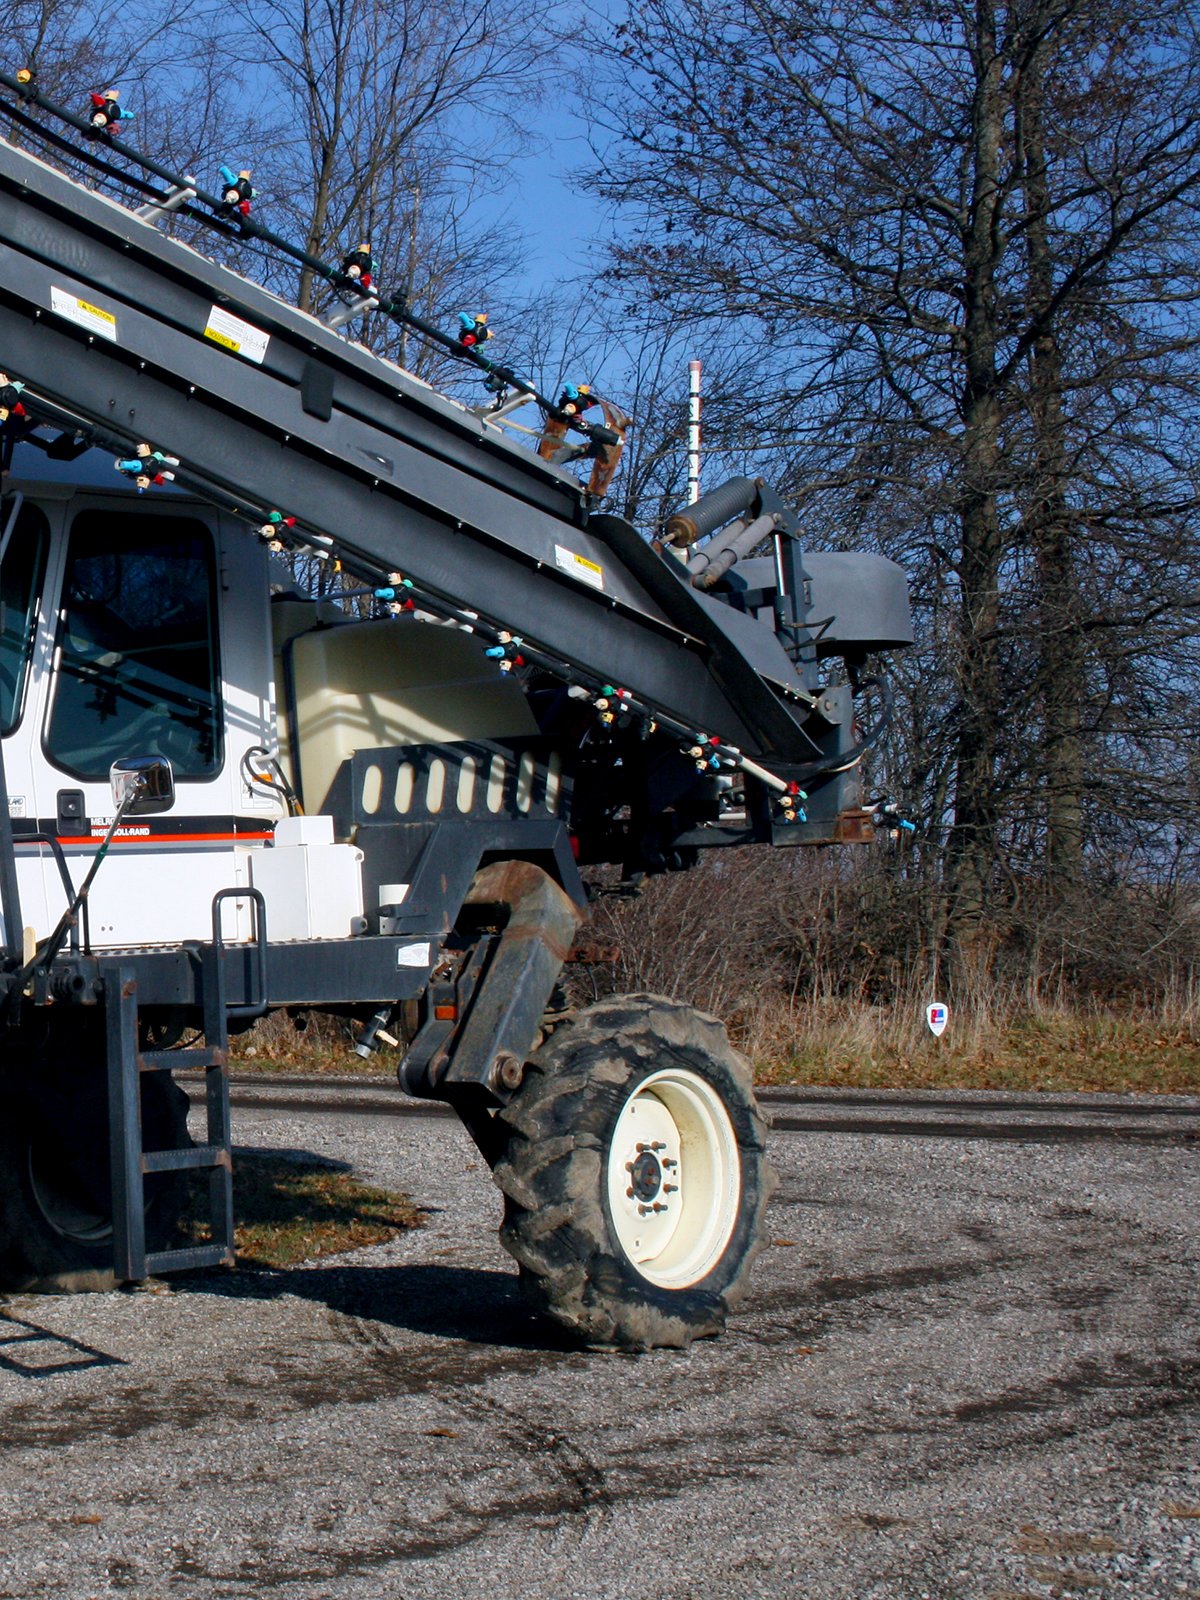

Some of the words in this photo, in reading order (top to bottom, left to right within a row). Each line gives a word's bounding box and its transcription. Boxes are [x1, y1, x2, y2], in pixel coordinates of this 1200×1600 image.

[88, 305, 113, 321] CAUTION
[91, 817, 120, 826] MELRO
[91, 827, 150, 837] INGEOLL-RAND
